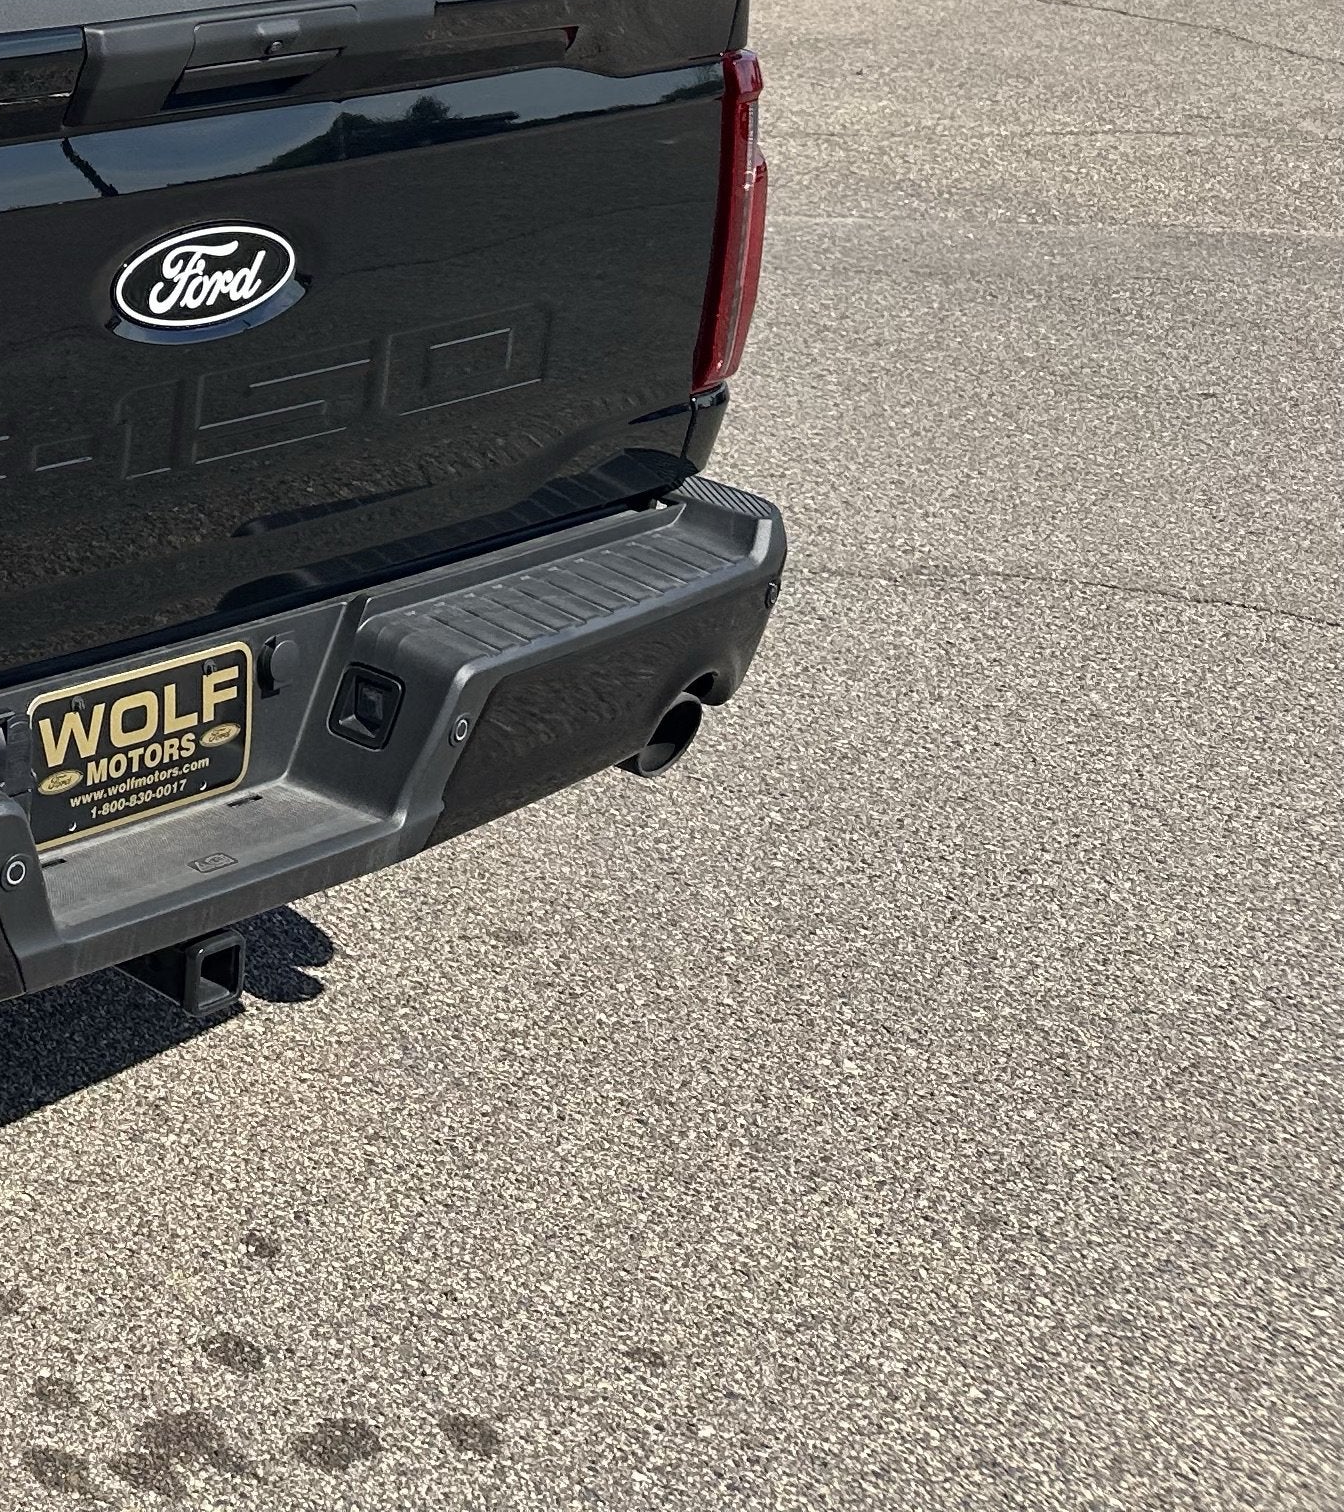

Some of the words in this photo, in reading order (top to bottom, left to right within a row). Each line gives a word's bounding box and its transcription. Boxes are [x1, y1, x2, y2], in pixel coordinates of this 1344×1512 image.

[149, 240, 267, 314] Ford
[37, 665, 240, 768] WOLF
[70, 757, 210, 808] www.wolfmotors.com
[86, 732, 197, 786] MOTORS
[90, 779, 188, 819] 1-800-830-0017
